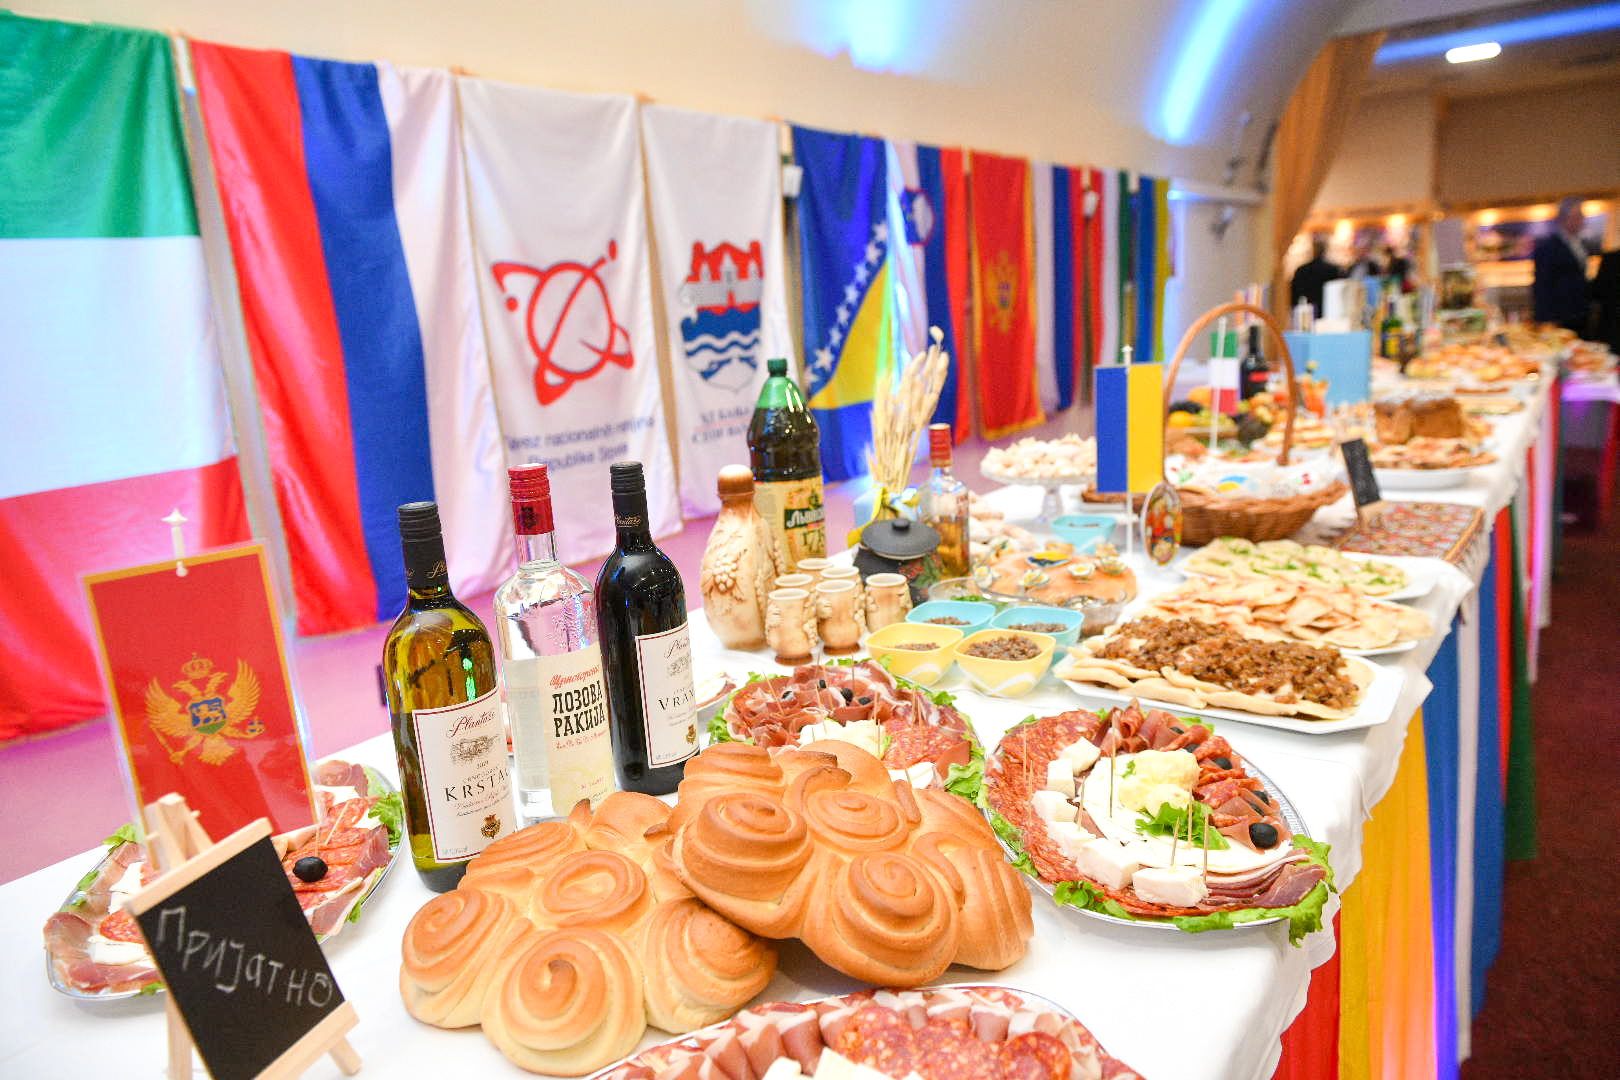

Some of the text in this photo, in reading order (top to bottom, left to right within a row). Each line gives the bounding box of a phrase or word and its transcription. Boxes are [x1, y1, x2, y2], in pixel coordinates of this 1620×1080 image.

[551, 679, 603, 715] ЛОЗОВА
[553, 702, 606, 738] РАКИЈА
[156, 905, 333, 1007] Пријатно
